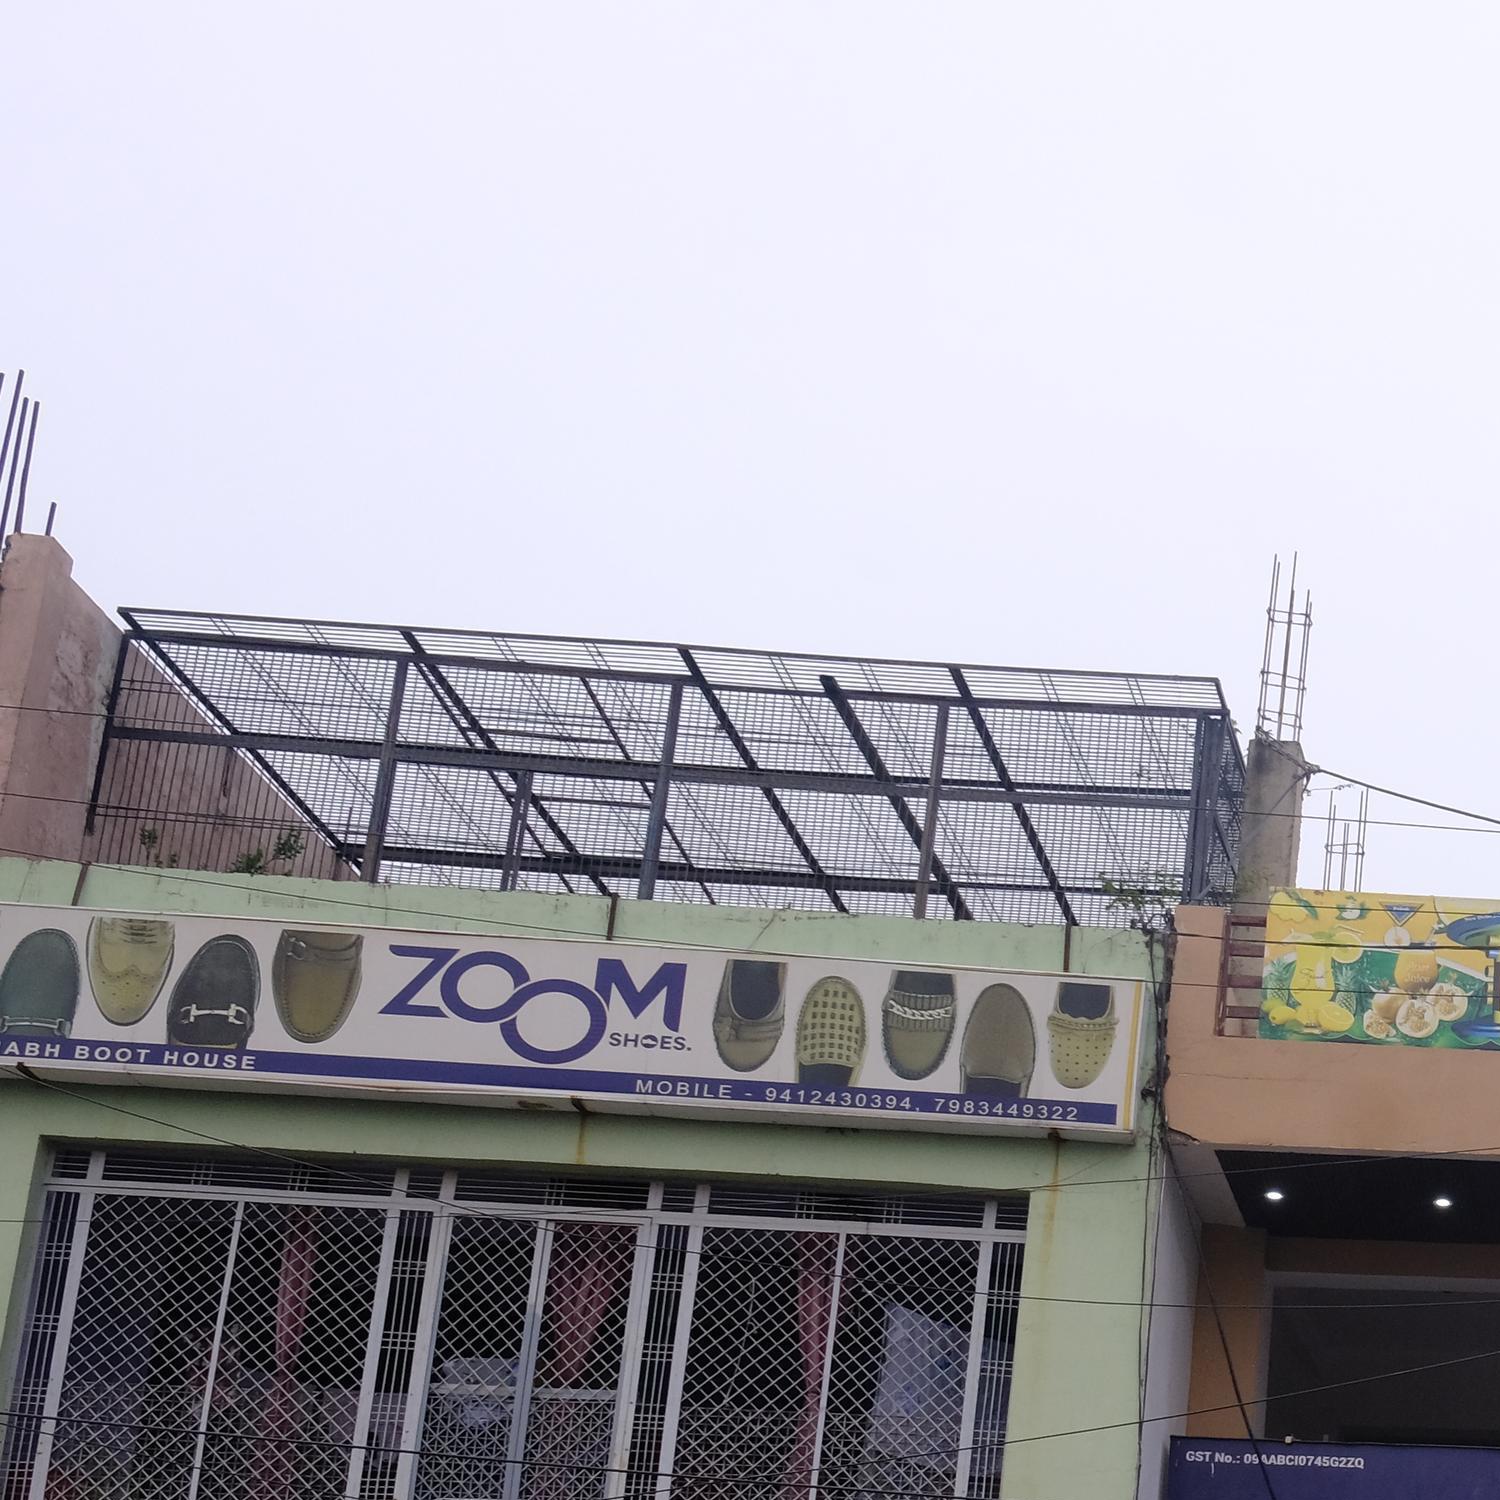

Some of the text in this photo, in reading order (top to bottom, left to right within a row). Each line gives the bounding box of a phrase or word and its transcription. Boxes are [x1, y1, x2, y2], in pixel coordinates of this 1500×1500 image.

[378, 944, 688, 1064] ZOOM
[0, 1040, 257, 1070] ABH BOOT HOUSE
[635, 1079, 733, 1100] MOBILE
[934, 1098, 1080, 1122] 7983449322
[1186, 1451, 1212, 1462] GST
